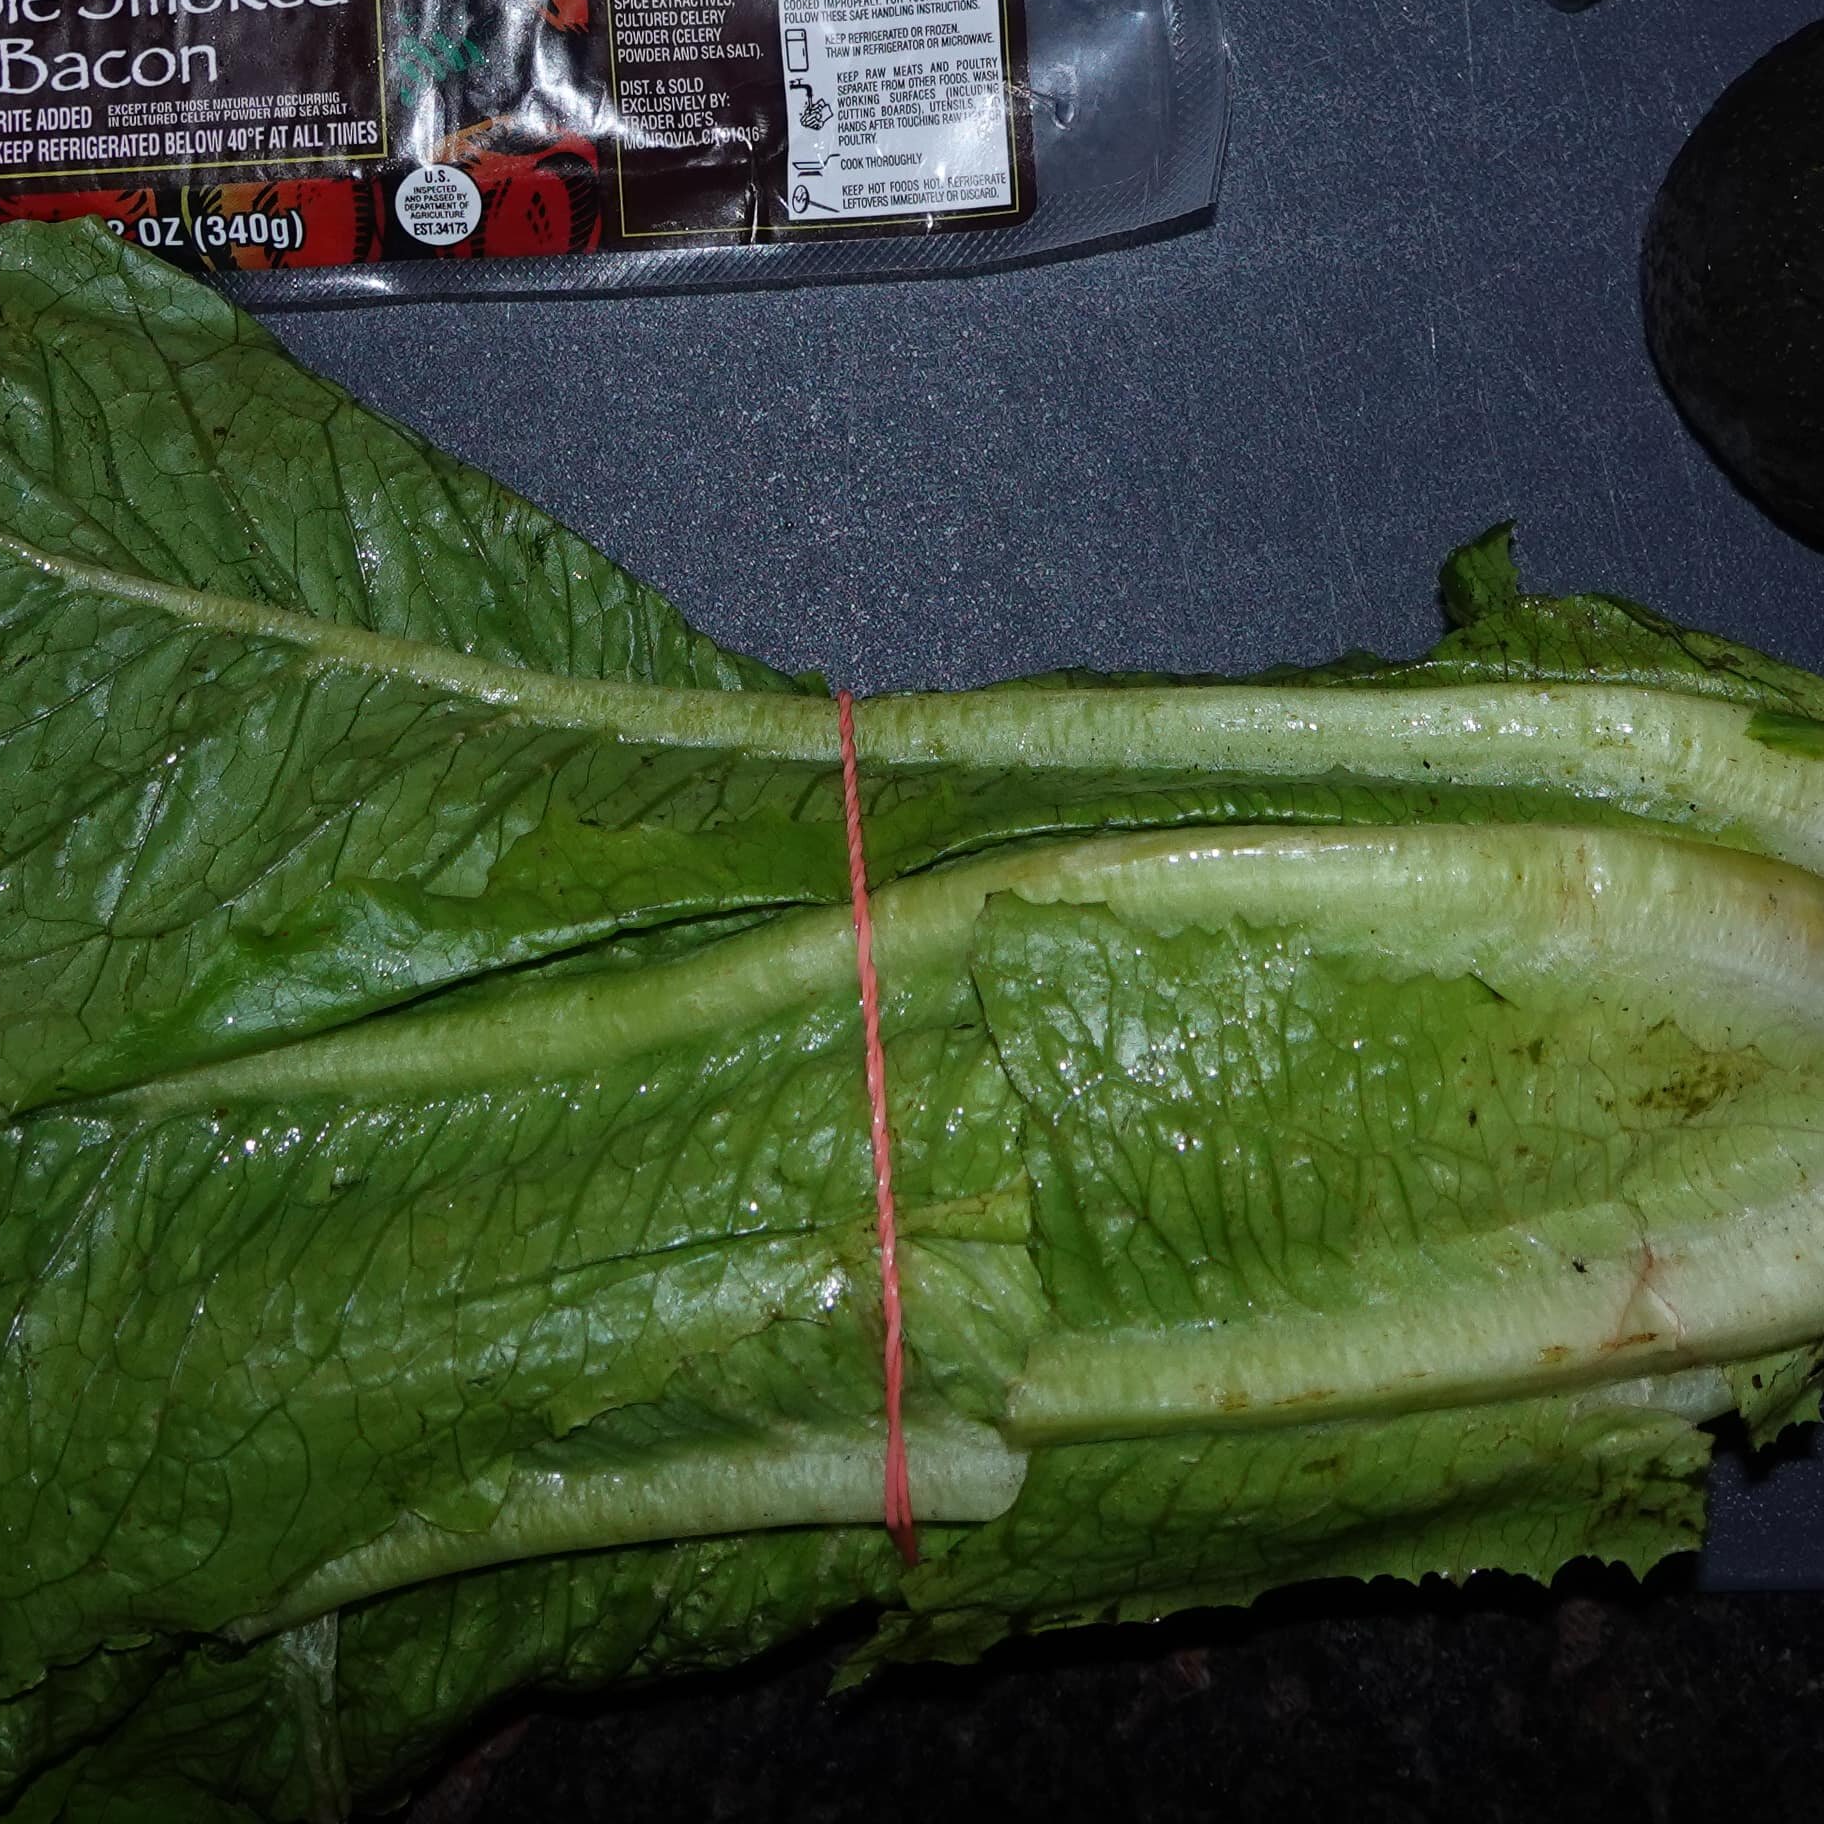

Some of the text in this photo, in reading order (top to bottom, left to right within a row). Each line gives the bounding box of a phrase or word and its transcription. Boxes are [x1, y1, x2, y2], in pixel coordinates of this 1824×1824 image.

[36, 106, 92, 130] ADDED
[37, 133, 160, 162] REFRIGERATED
[165, 129, 223, 156] BELOW
[269, 126, 290, 149] AT
[293, 124, 324, 148] ALL
[327, 120, 378, 146] TIMES
[140, 216, 183, 248] OZ
[194, 209, 304, 255] (340g)
